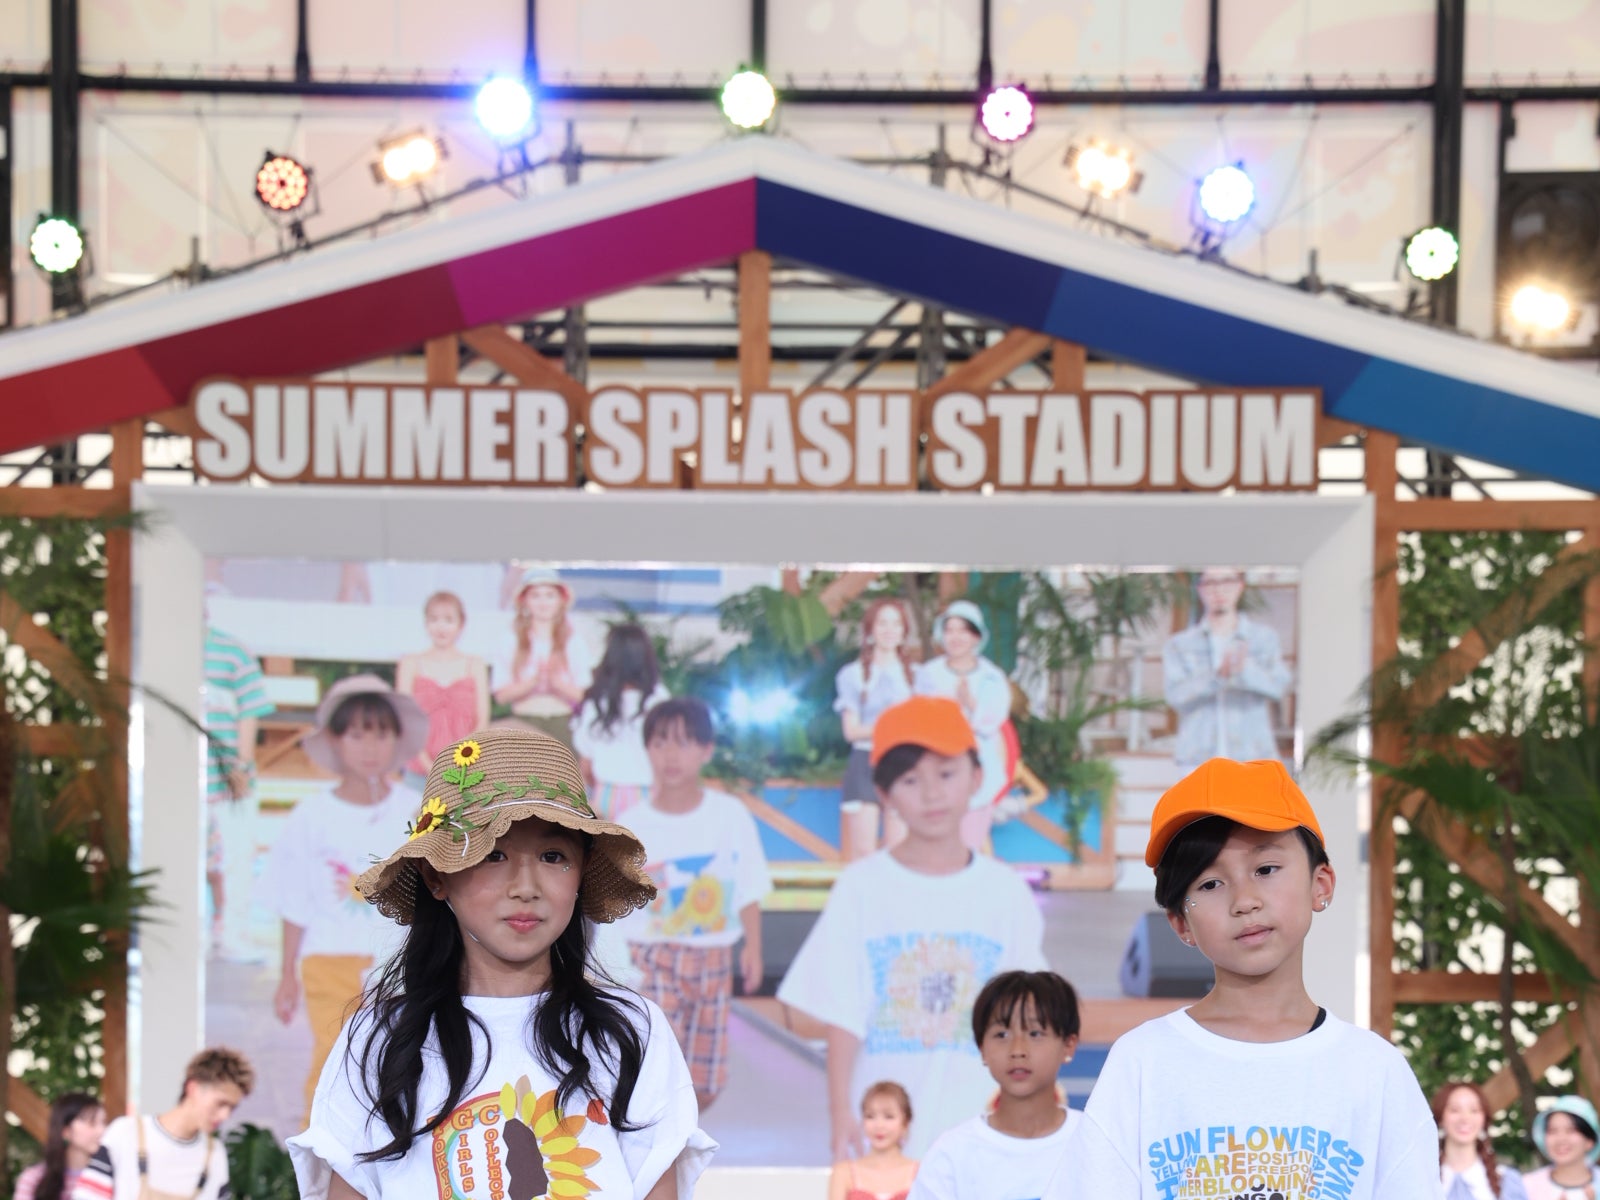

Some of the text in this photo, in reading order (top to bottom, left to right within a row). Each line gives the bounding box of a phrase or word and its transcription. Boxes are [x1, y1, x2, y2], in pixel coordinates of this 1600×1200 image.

[196, 383, 1315, 486] SUMMER SPLASH STADIUM
[452, 1109, 475, 1193] GIRLS
[1148, 1127, 1201, 1168] SUN
[1194, 1152, 1246, 1177] ARE
[1203, 1172, 1307, 1197] BLOOMIN
